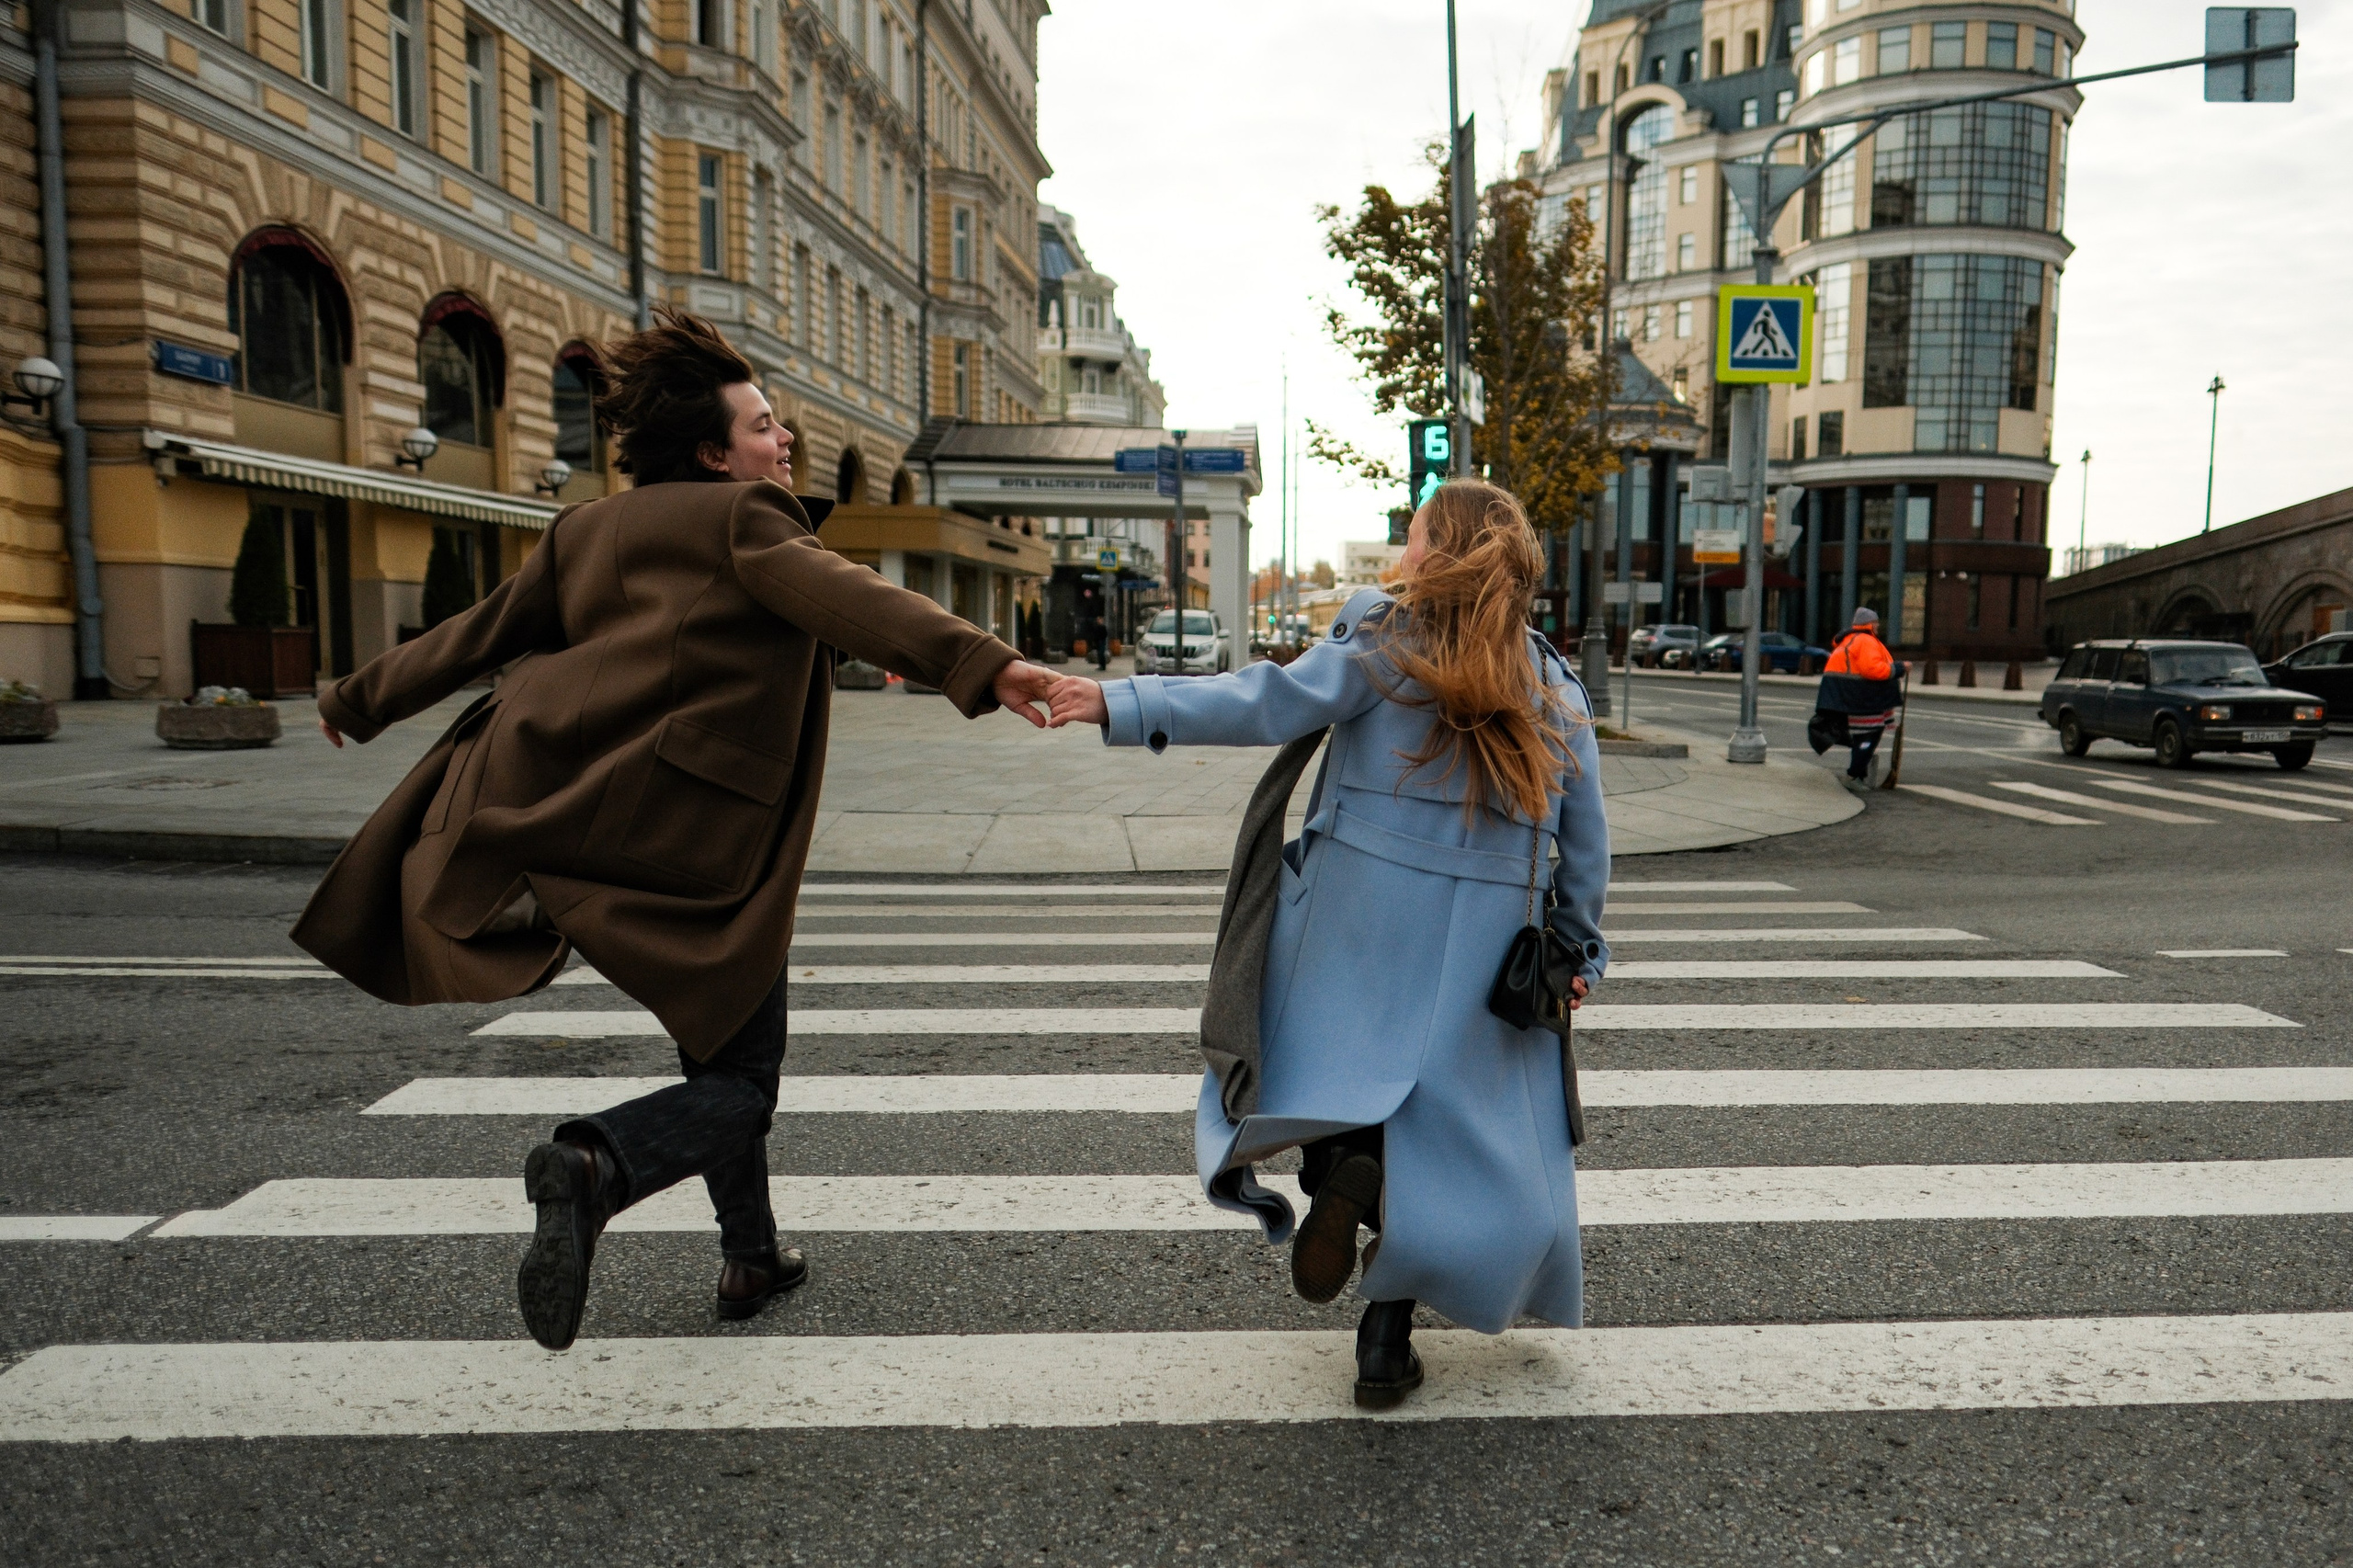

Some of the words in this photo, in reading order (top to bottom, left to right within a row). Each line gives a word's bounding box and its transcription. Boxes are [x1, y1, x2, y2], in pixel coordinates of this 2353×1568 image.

[1425, 426, 1449, 460] 6
[999, 478, 1032, 487] HOTEL
[1099, 481, 1154, 490] KEMPINSKI
